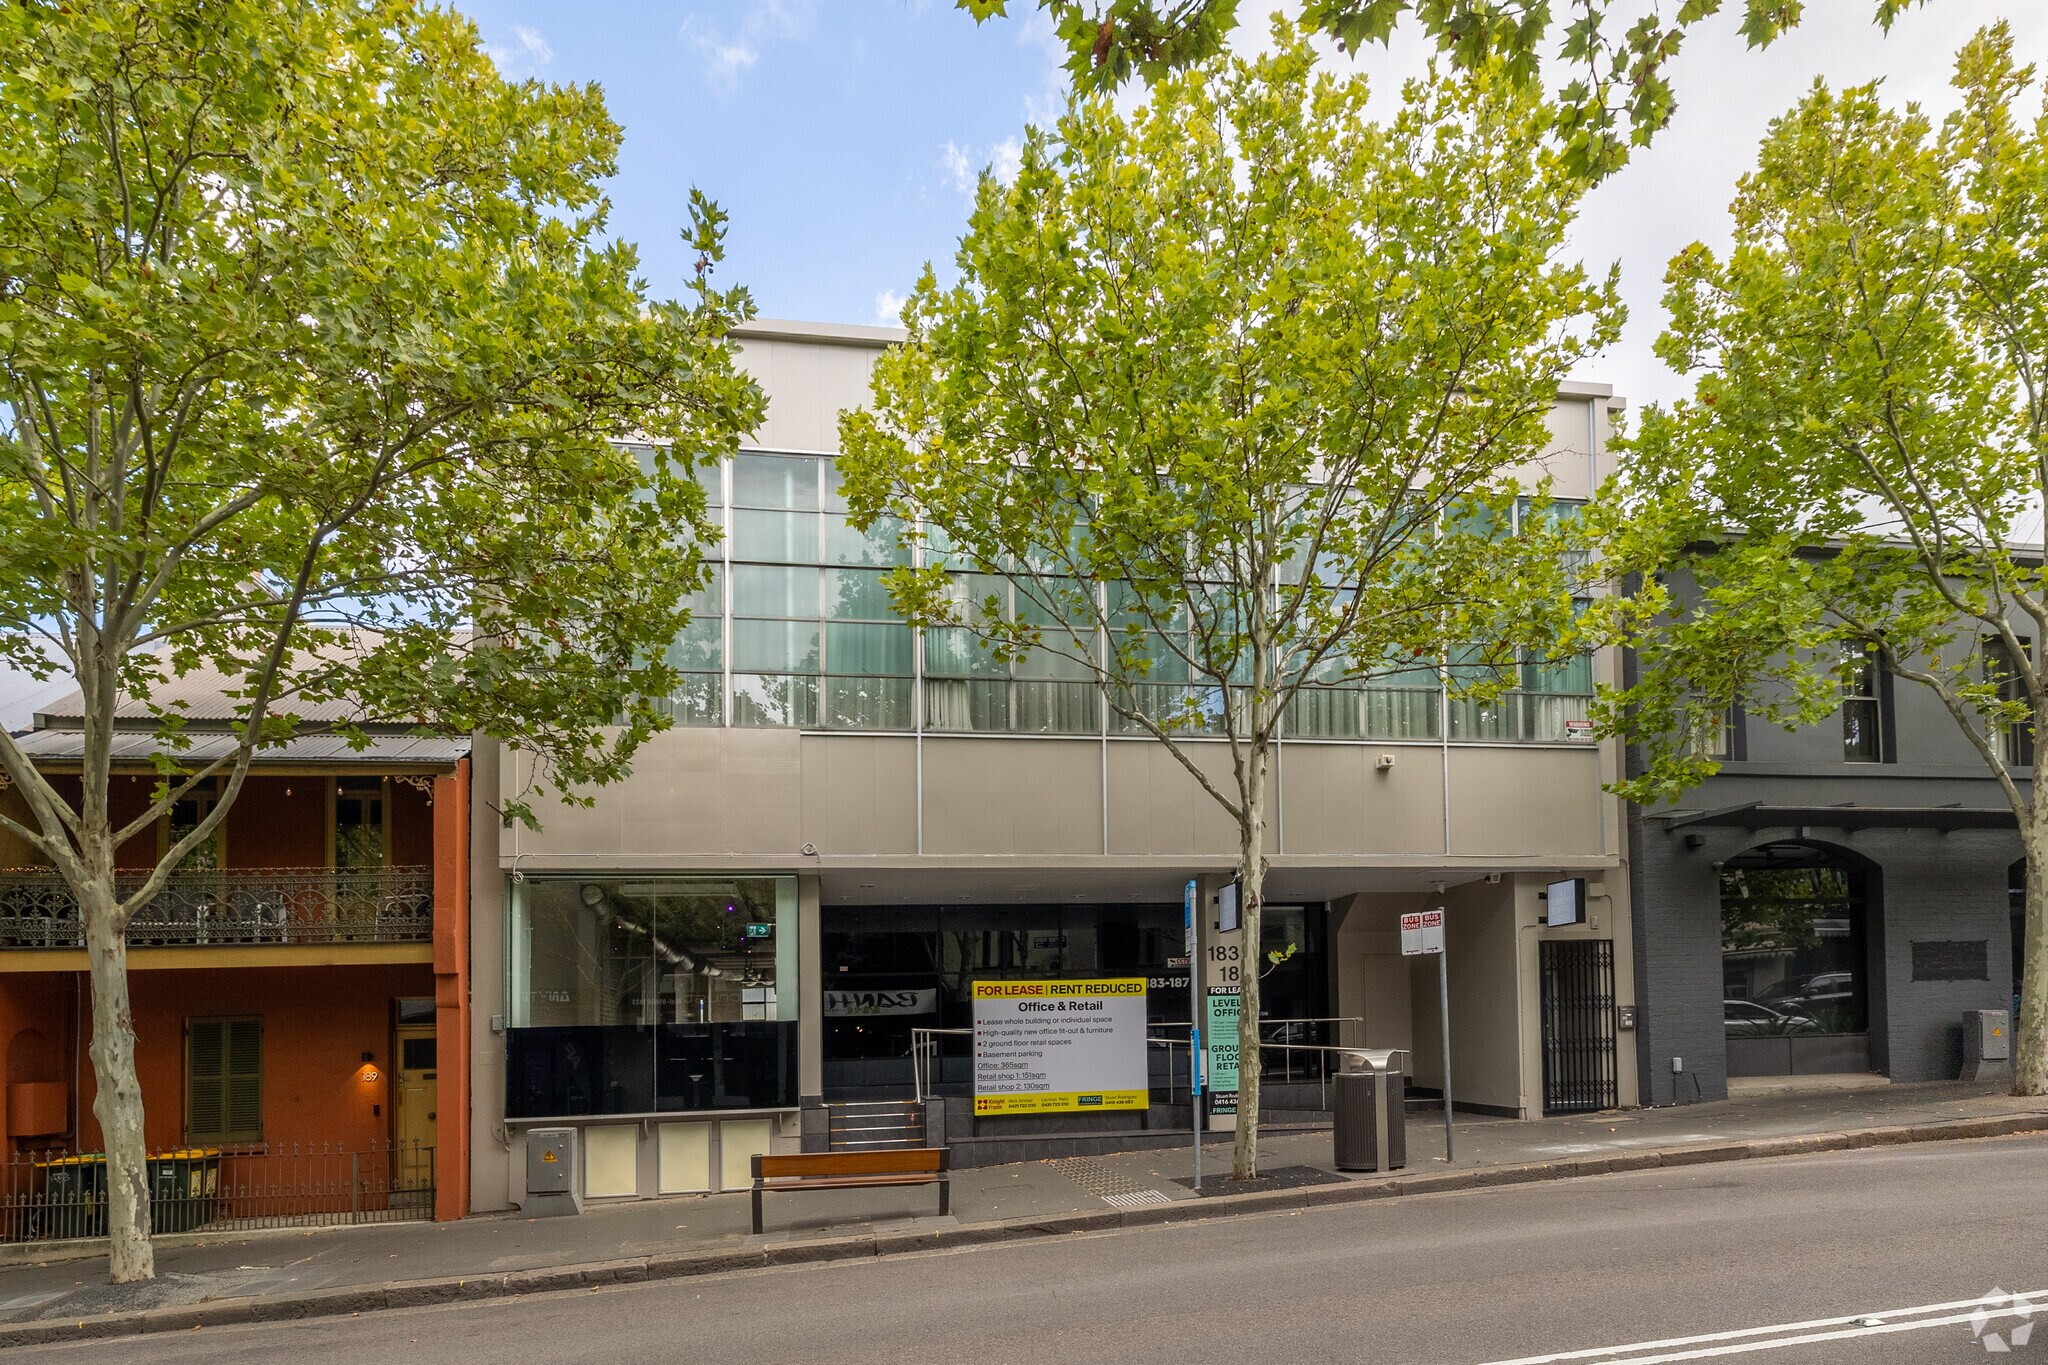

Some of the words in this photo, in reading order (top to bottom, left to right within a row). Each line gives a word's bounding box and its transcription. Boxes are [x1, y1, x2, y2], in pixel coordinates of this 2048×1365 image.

[1208, 946, 1239, 961] 183
[977, 986, 1002, 995] FOR
[1005, 985, 1043, 995] LEASE
[1050, 984, 1083, 994] RENT
[1086, 984, 1142, 994] REDUCED
[1018, 1002, 1055, 1012] Office
[1058, 1002, 1066, 1011] &
[1069, 1001, 1103, 1011] Retail
[983, 1029, 1022, 1037] High-quality
[989, 1040, 1012, 1048] ground
